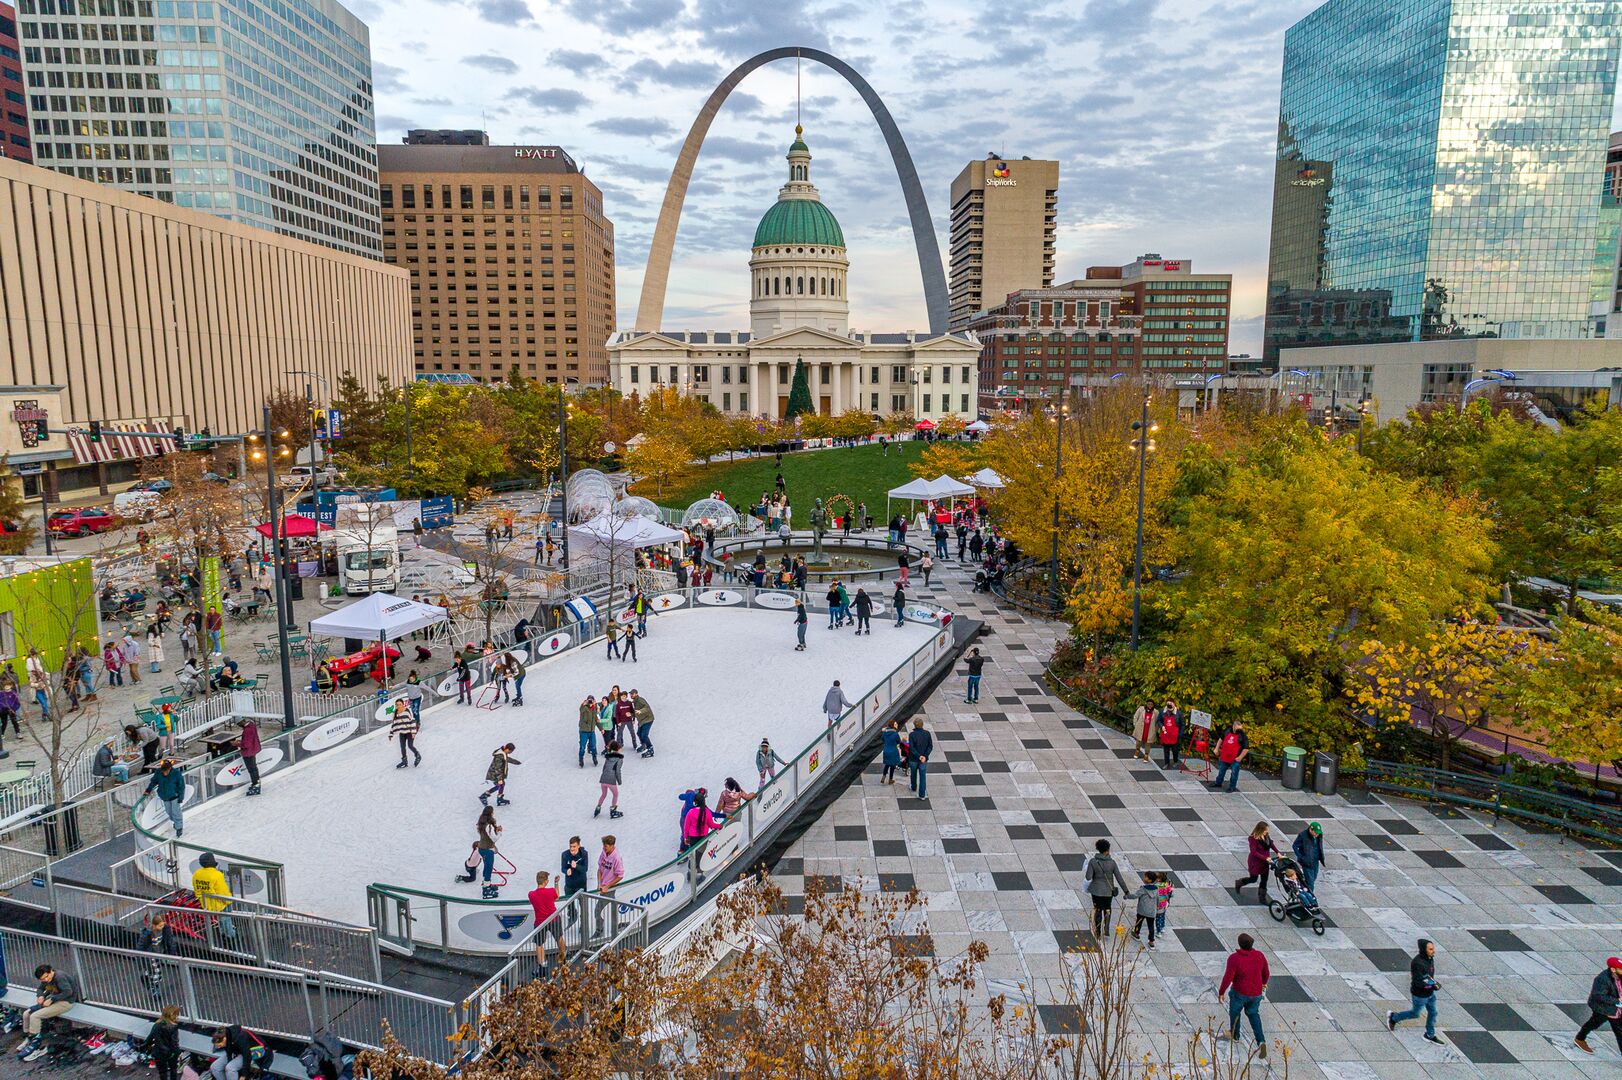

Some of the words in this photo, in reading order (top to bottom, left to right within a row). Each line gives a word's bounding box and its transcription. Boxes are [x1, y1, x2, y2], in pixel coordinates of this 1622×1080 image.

[515, 149, 557, 159] HYATT
[986, 179, 1017, 187] ShipWorks
[298, 511, 333, 520] NTEREST
[326, 721, 350, 735] WINTERFEST
